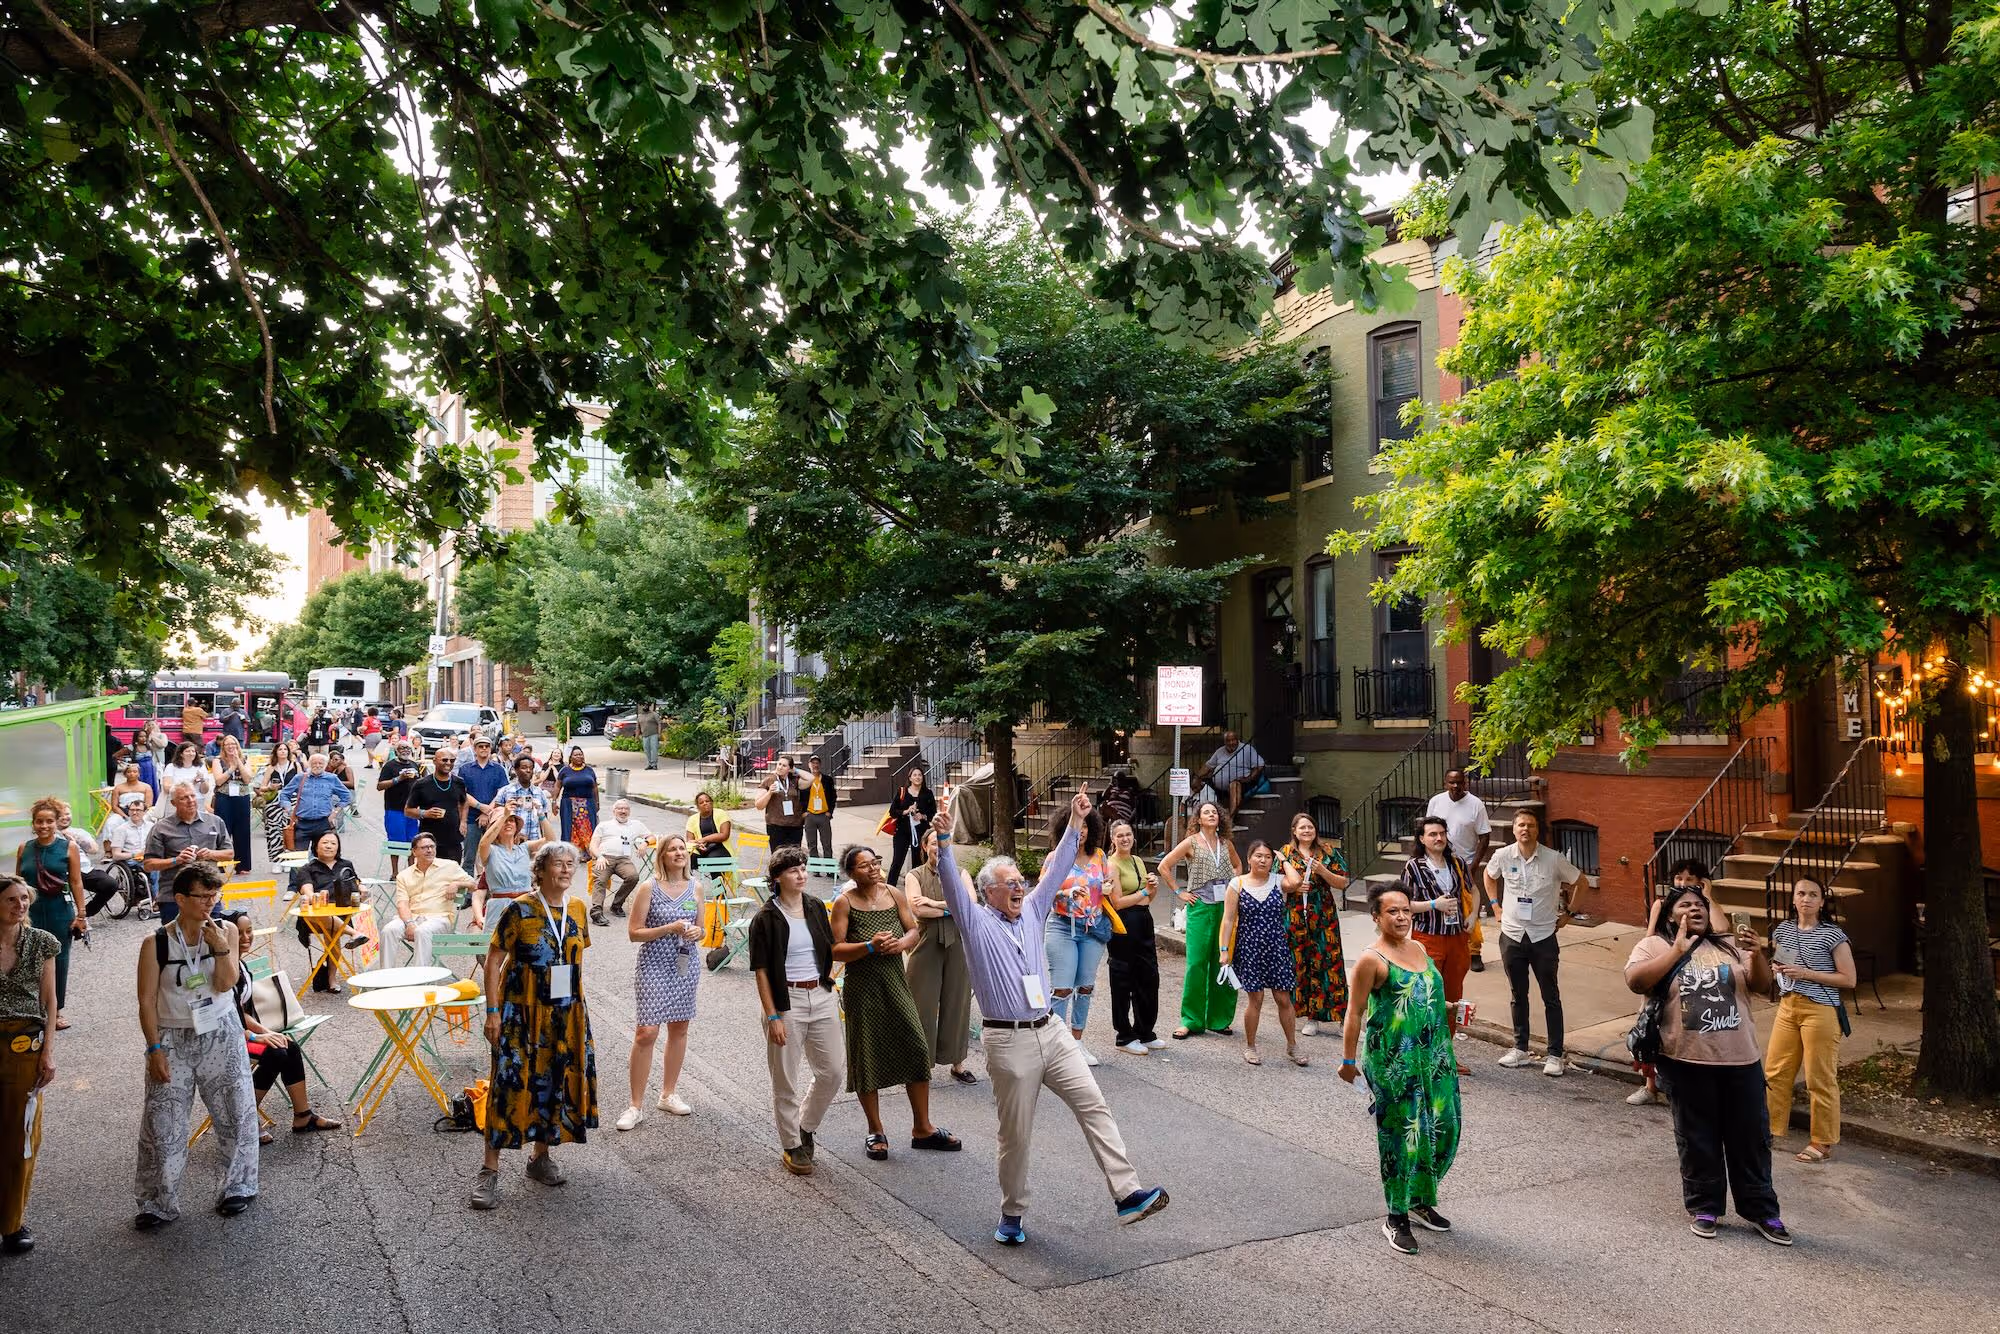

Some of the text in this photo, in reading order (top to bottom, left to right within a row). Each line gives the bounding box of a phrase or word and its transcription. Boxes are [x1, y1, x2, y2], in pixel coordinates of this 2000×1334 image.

[1160, 668, 1171, 677] NO
[176, 680, 219, 688] QUEENS
[1164, 680, 1195, 689] MONDAY
[1699, 1005, 1742, 1034] Smalls
